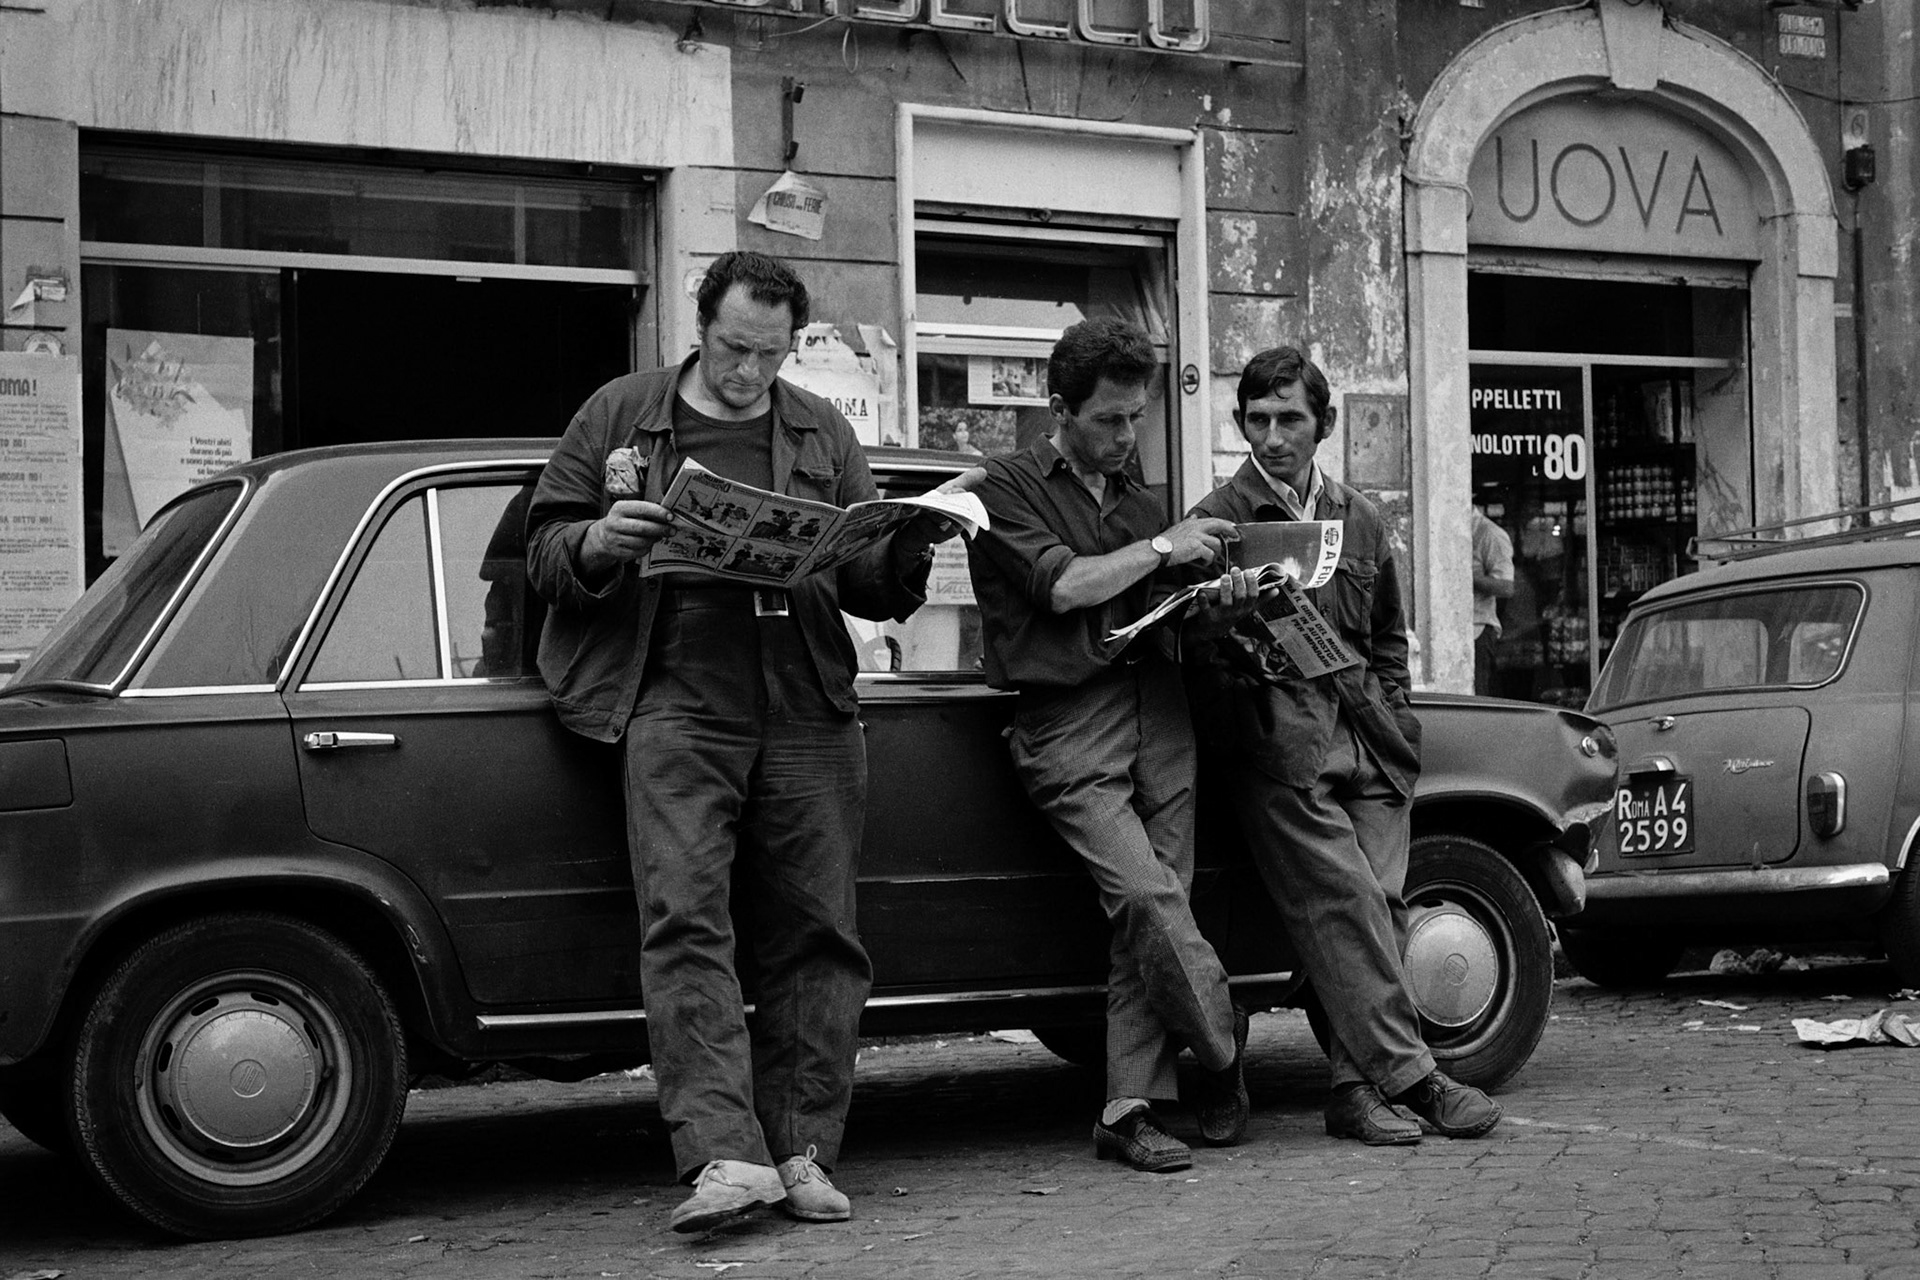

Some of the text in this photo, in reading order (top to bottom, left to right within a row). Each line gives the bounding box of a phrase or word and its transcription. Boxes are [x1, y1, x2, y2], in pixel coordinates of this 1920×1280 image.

[1495, 136, 1723, 236] UOVA
[1472, 388, 1562, 411] PPELLETTI
[1470, 433, 1542, 455] NOLOTTI
[1543, 433, 1586, 480] 80
[1290, 618, 1333, 669] PER IMPARARE
[1299, 616, 1338, 662] IN AUTOSTOP
[1300, 604, 1318, 622] GIRO
[1314, 623, 1328, 637] DEL
[1325, 637, 1350, 664] MONDO
[1619, 816, 1688, 853] 2599
